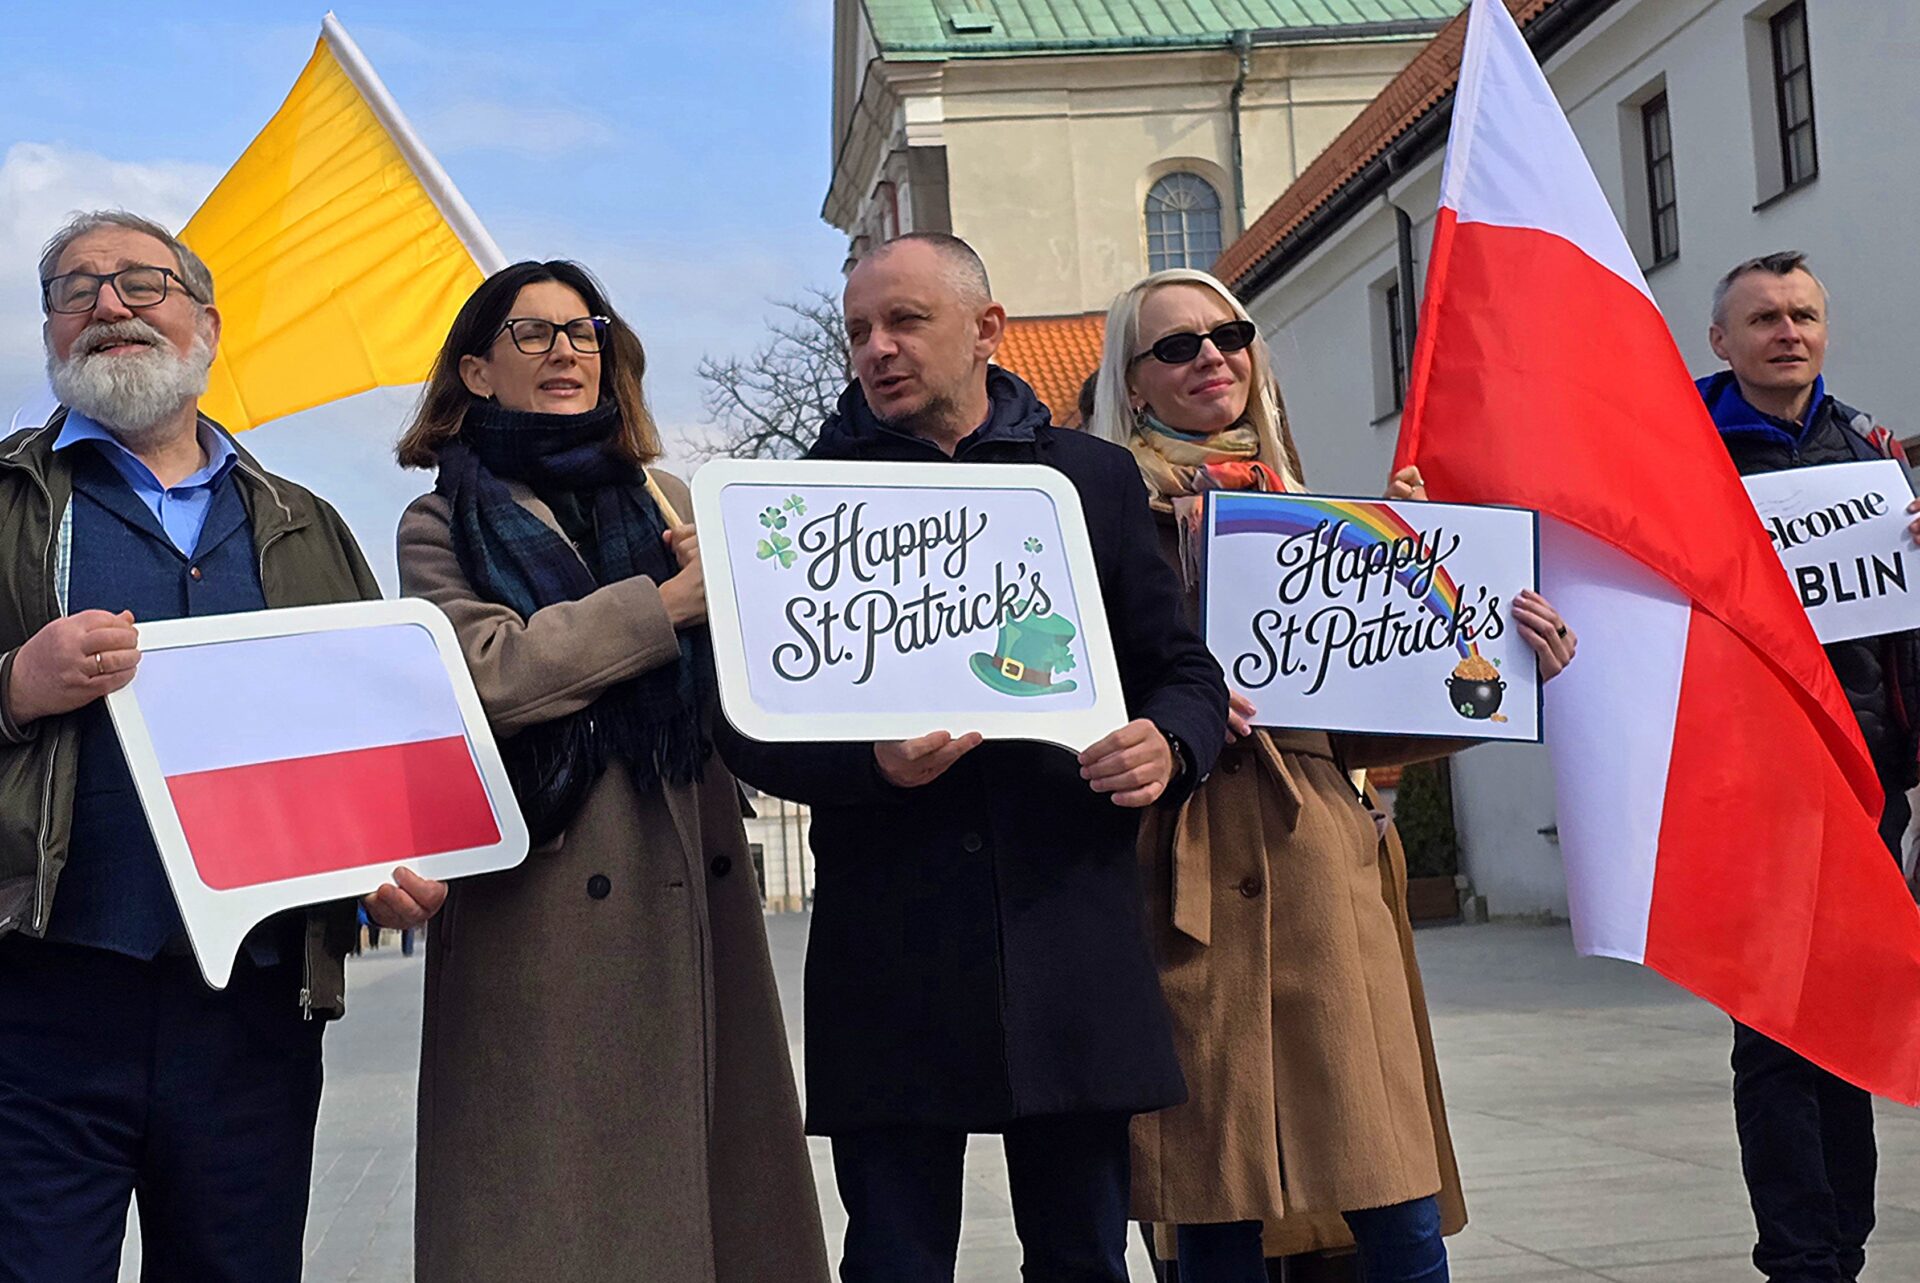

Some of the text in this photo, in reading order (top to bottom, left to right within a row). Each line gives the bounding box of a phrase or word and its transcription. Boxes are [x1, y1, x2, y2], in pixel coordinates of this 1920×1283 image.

[798, 502, 988, 591] Happy
[1276, 518, 1461, 605] Happy
[1795, 551, 1908, 608] BLIN
